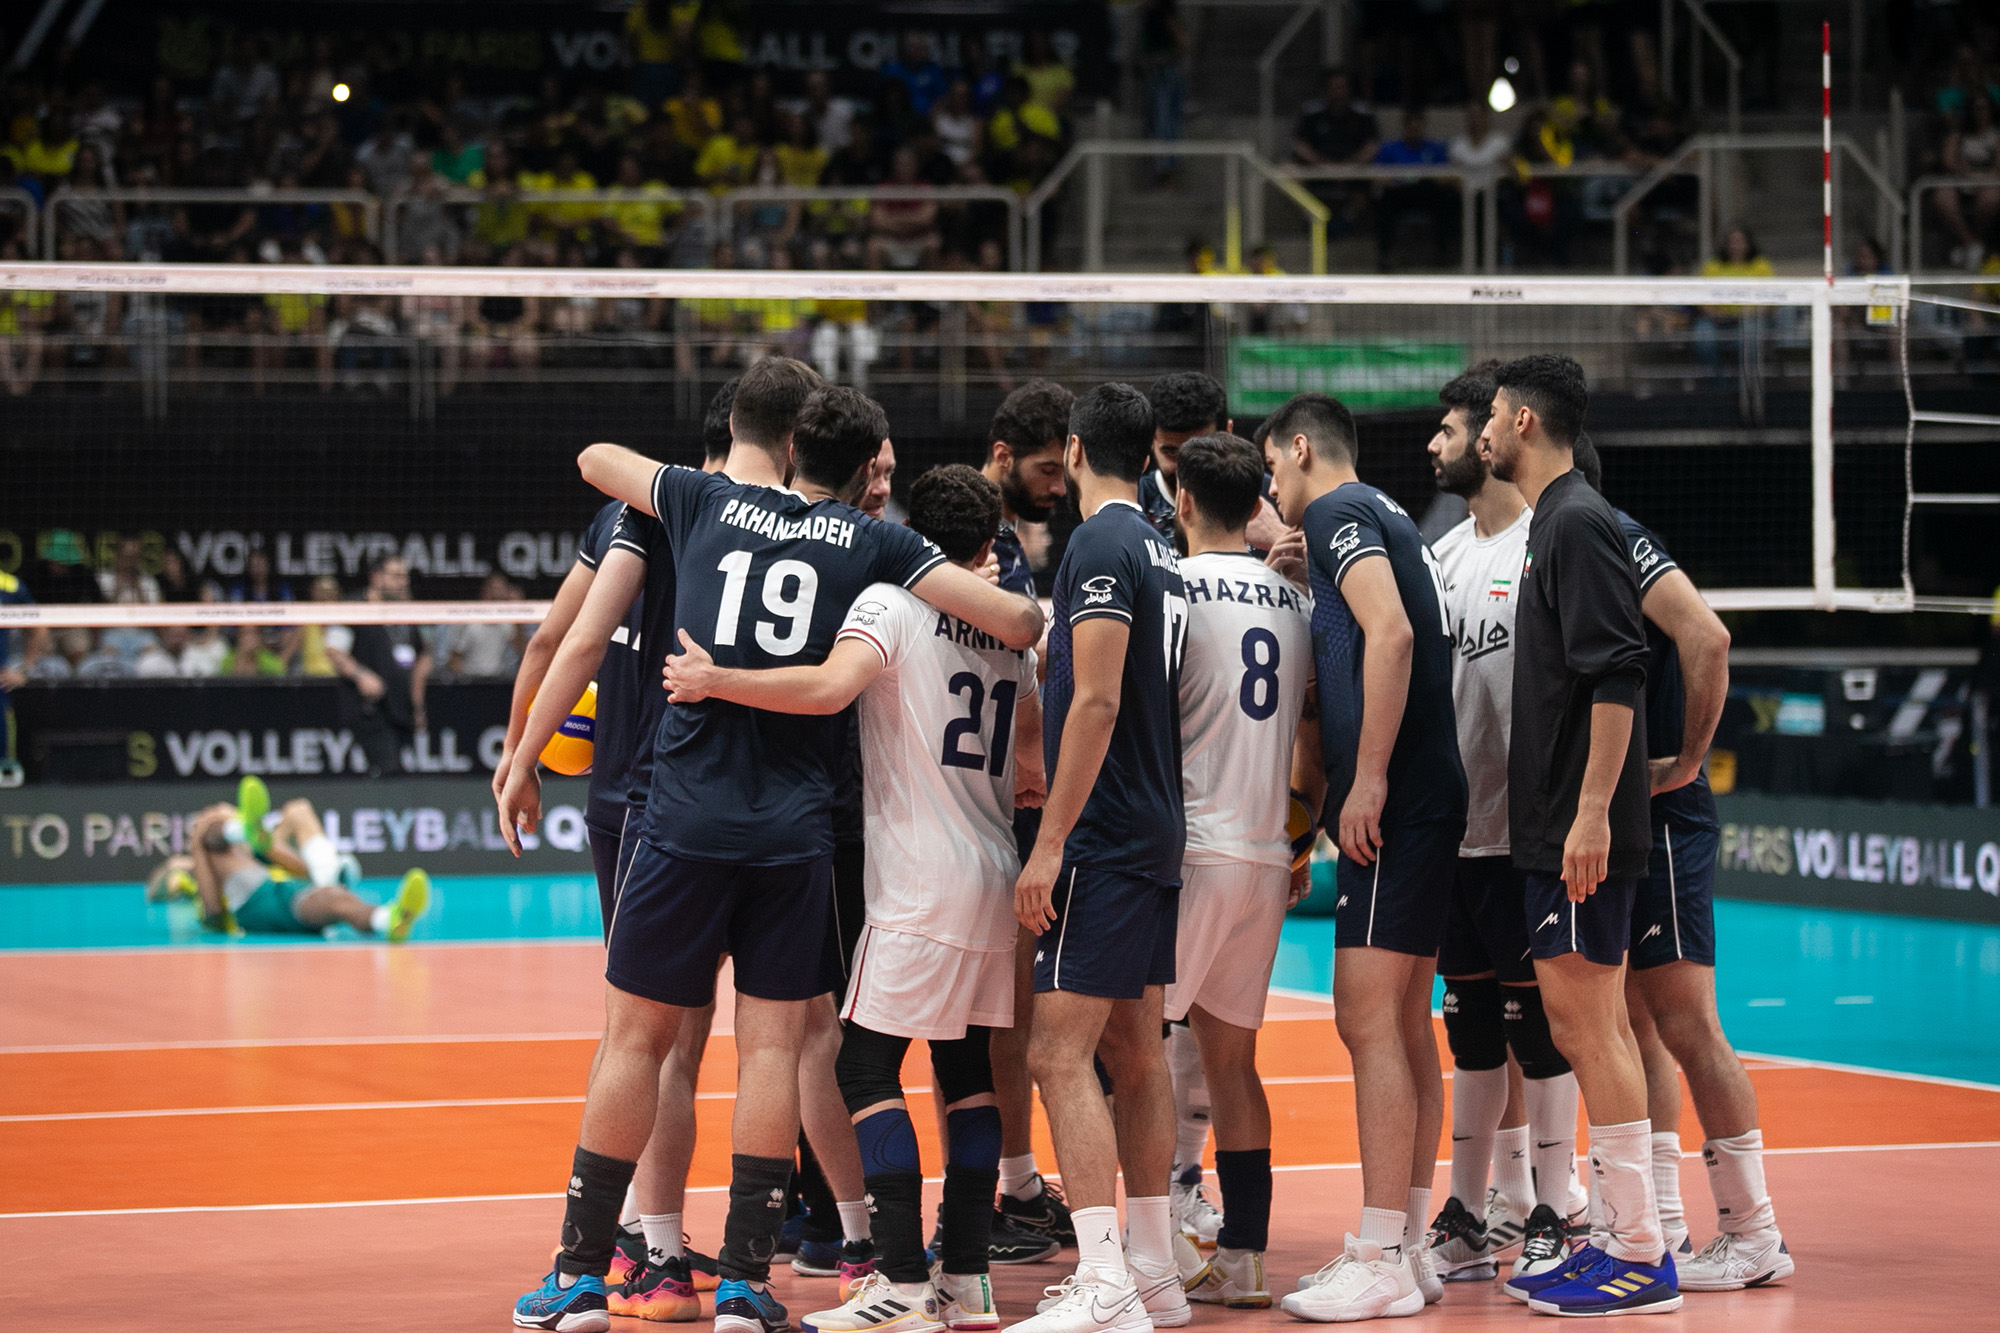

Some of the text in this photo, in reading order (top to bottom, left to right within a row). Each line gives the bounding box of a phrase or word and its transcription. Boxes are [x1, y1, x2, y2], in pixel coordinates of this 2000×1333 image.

[720, 500, 855, 549] P.KHANZADEH
[714, 550, 818, 656] 19
[1163, 591, 1188, 682] 17
[1239, 627, 1280, 721] 8
[941, 671, 1017, 777] 21
[3, 814, 69, 860] TO
